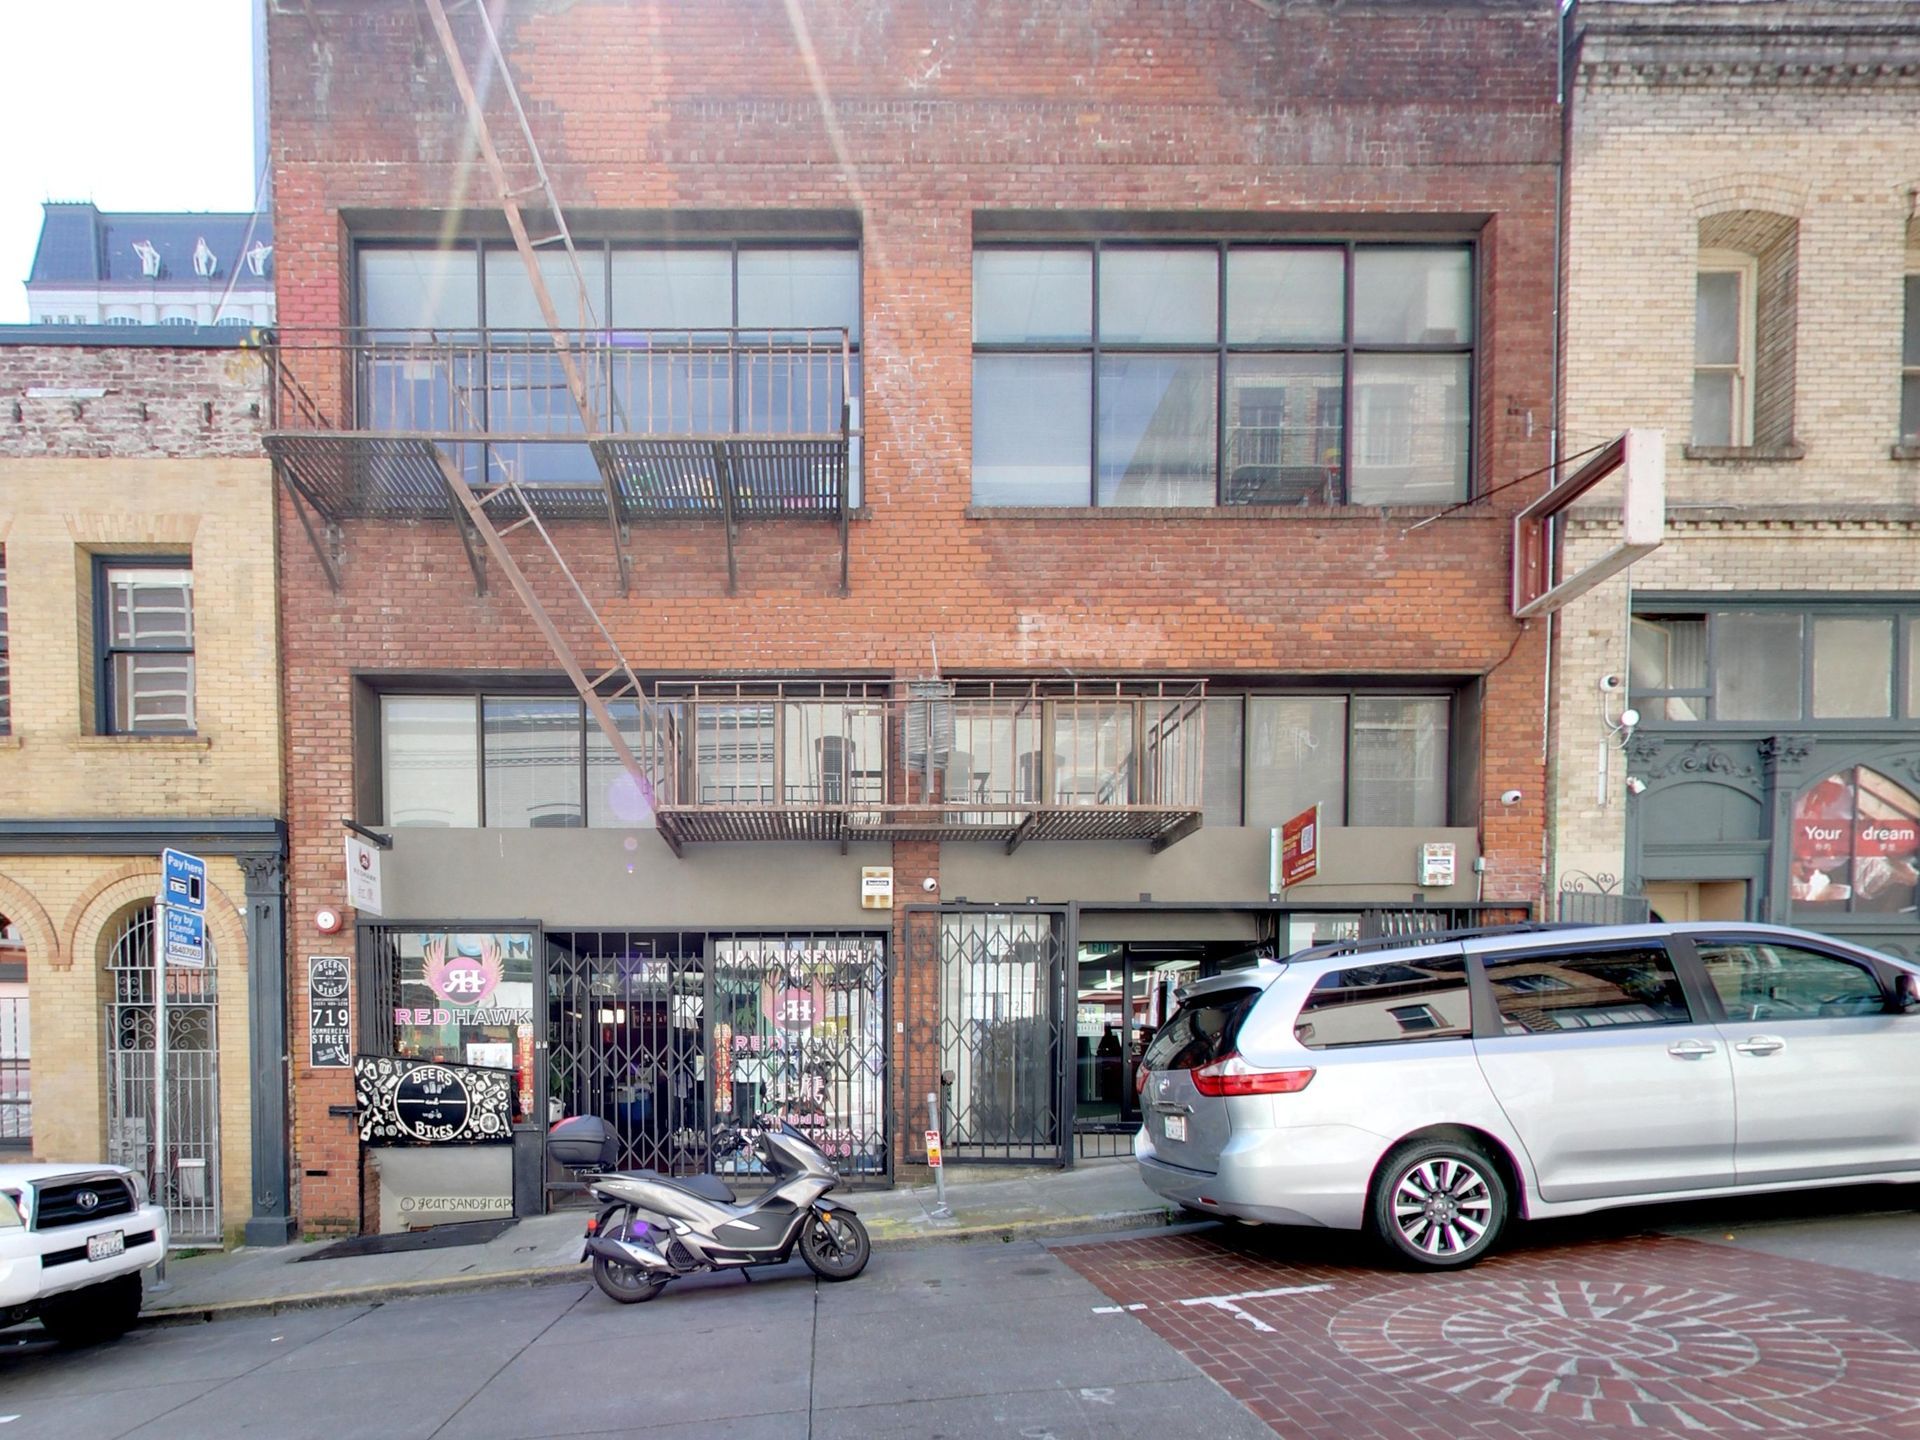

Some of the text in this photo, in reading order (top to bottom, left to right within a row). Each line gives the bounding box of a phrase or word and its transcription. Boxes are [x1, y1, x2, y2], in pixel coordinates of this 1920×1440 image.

[1805, 826, 1914, 840] Your dream
[168, 855, 203, 875] Pay here
[169, 911, 193, 928] Pay by
[169, 921, 195, 936] License
[169, 931, 187, 943] Plate
[318, 961, 343, 972] BEERS
[318, 984, 343, 996] BIKES
[312, 1009, 349, 1026] 719
[394, 1008, 532, 1026] REDHAWK
[312, 1035, 349, 1044] STREET
[412, 1069, 453, 1086] BEERS
[415, 1121, 453, 1139] BIKES
[798, 1128, 862, 1140] XPRESS
